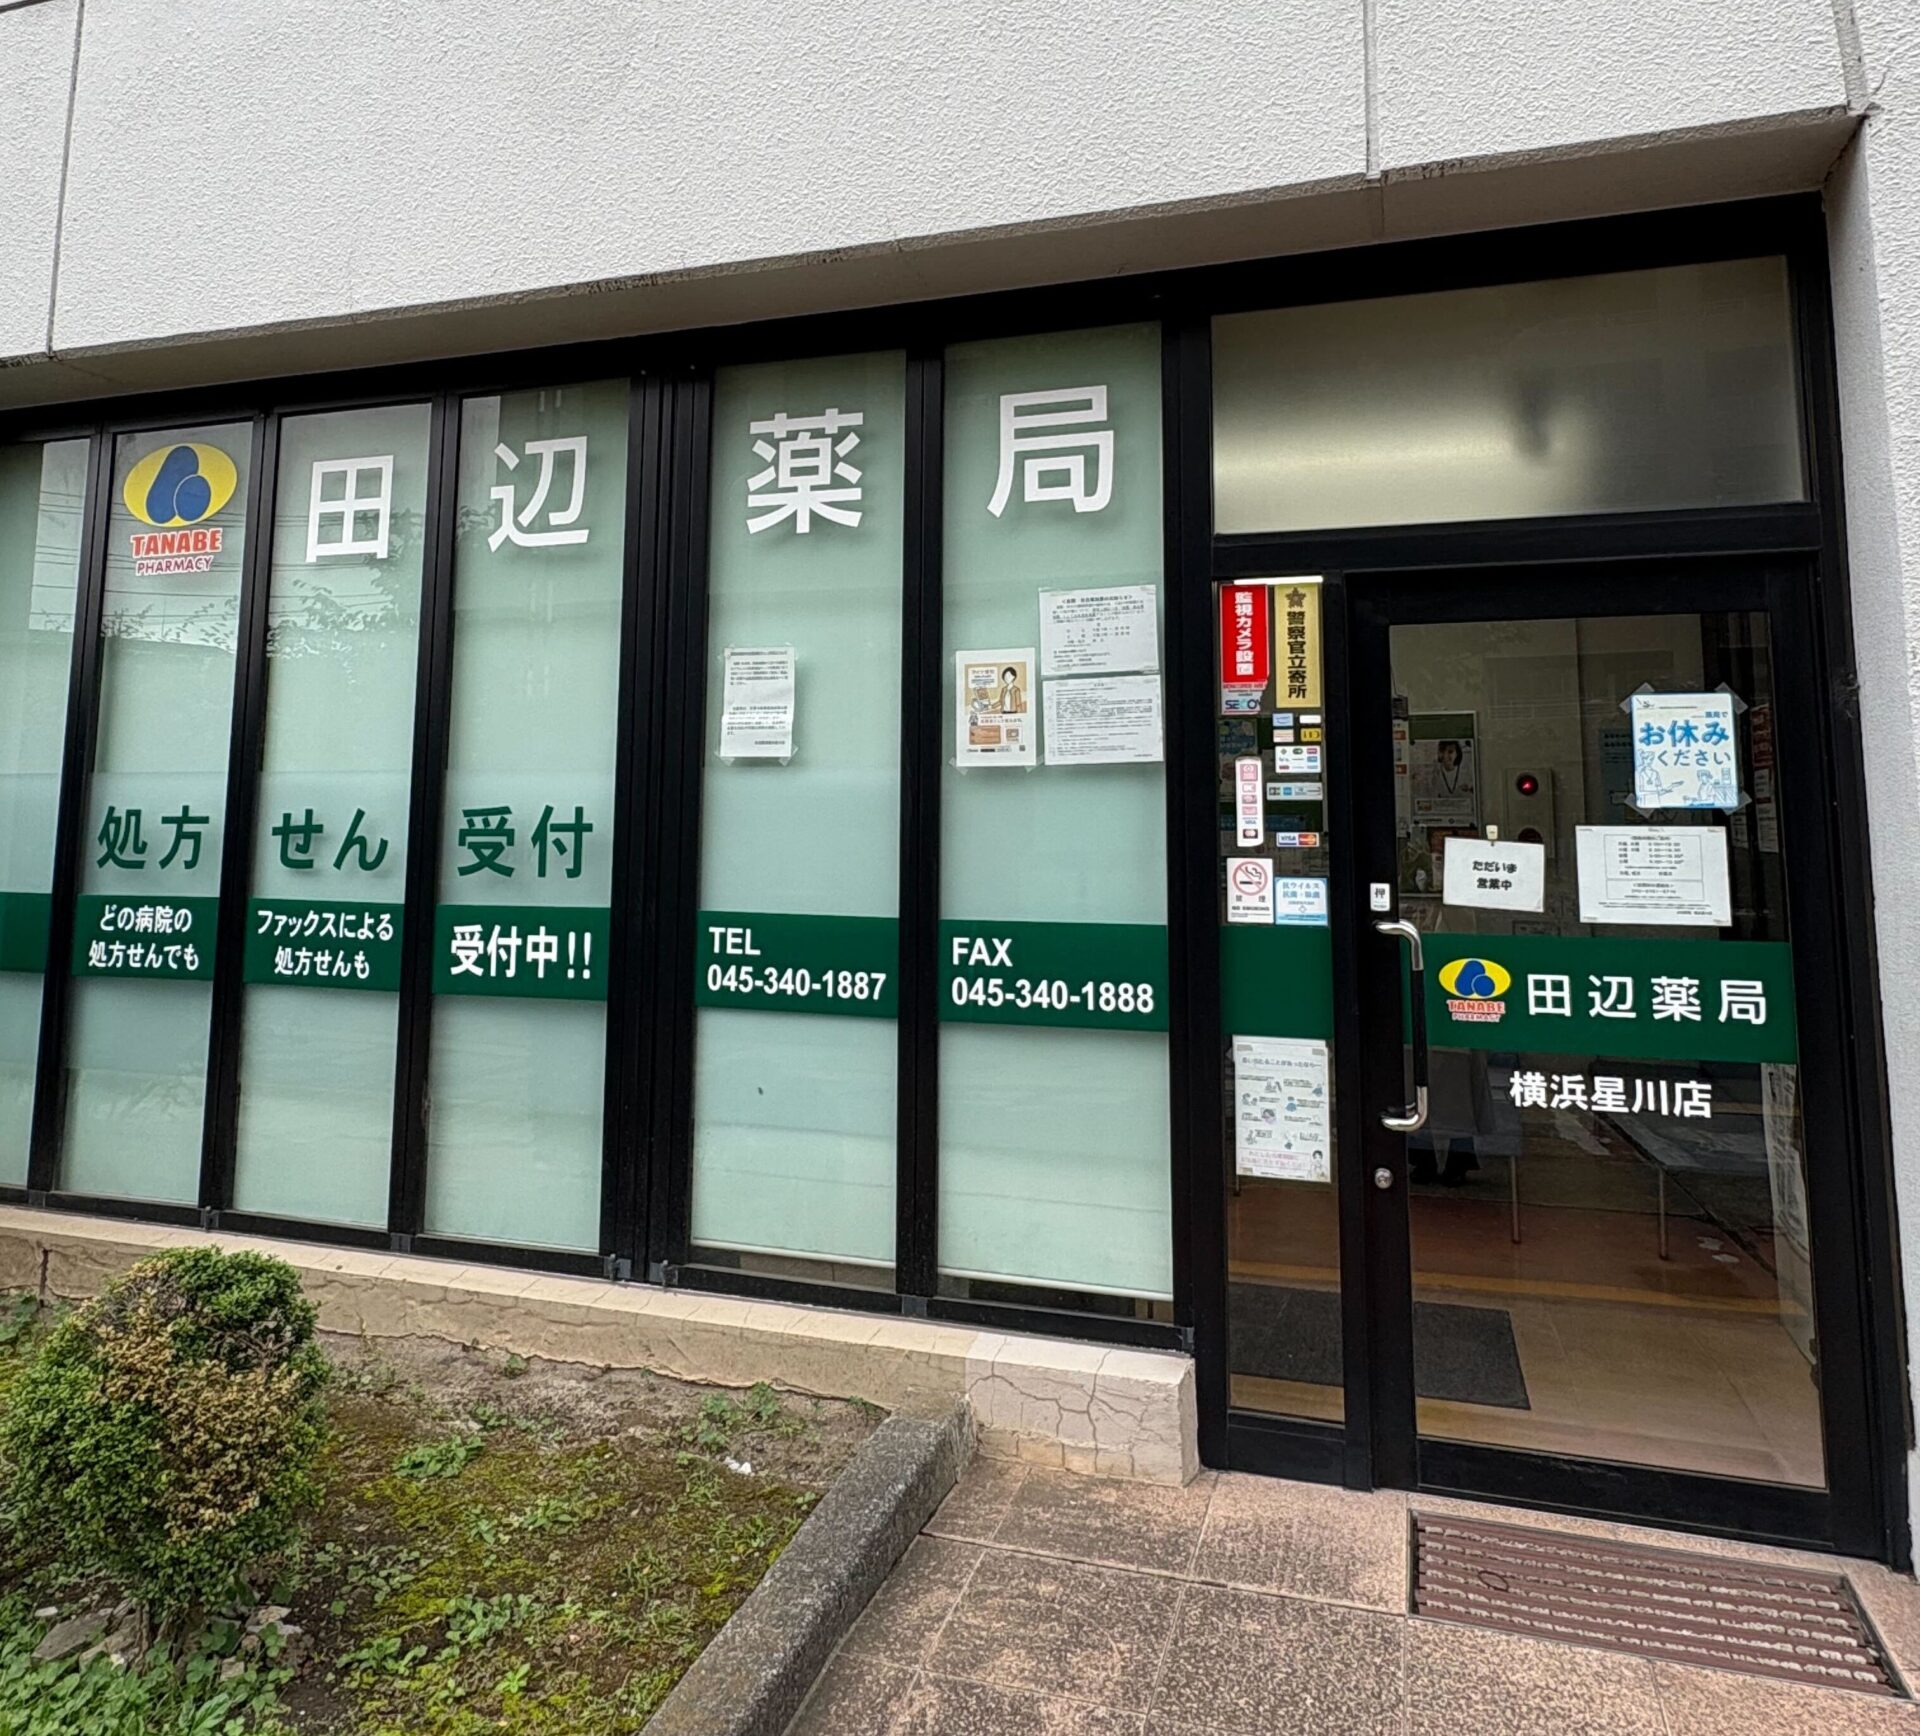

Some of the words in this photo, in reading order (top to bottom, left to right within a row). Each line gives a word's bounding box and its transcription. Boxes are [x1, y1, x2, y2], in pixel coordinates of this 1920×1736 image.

[131, 528, 222, 558] TANABE
[136, 556, 213, 576] PHARMACY
[1234, 592, 1254, 676] 監視カメラ設置
[1287, 611, 1307, 699] 警察官立寄所
[1639, 720, 1729, 747] お休み
[1657, 749, 1731, 766] ください
[1472, 860, 1518, 874] ただいま
[1374, 887, 1386, 899] 押
[1475, 877, 1513, 891] 営業中
[100, 905, 192, 934] どの病院の
[257, 910, 394, 941] ファックスによる
[88, 940, 199, 971] 処方せんでも
[709, 926, 761, 956] TEL
[951, 937, 1014, 968] FAX
[274, 946, 370, 979] 処方せんも
[707, 965, 886, 1001] 045-340-1887
[951, 977, 1155, 1014] 045-340-1888
[1446, 1000, 1505, 1014] TANABE
[1526, 973, 1767, 1025] 田辺薬局
[1509, 1070, 1713, 1119] 横浜星川店
